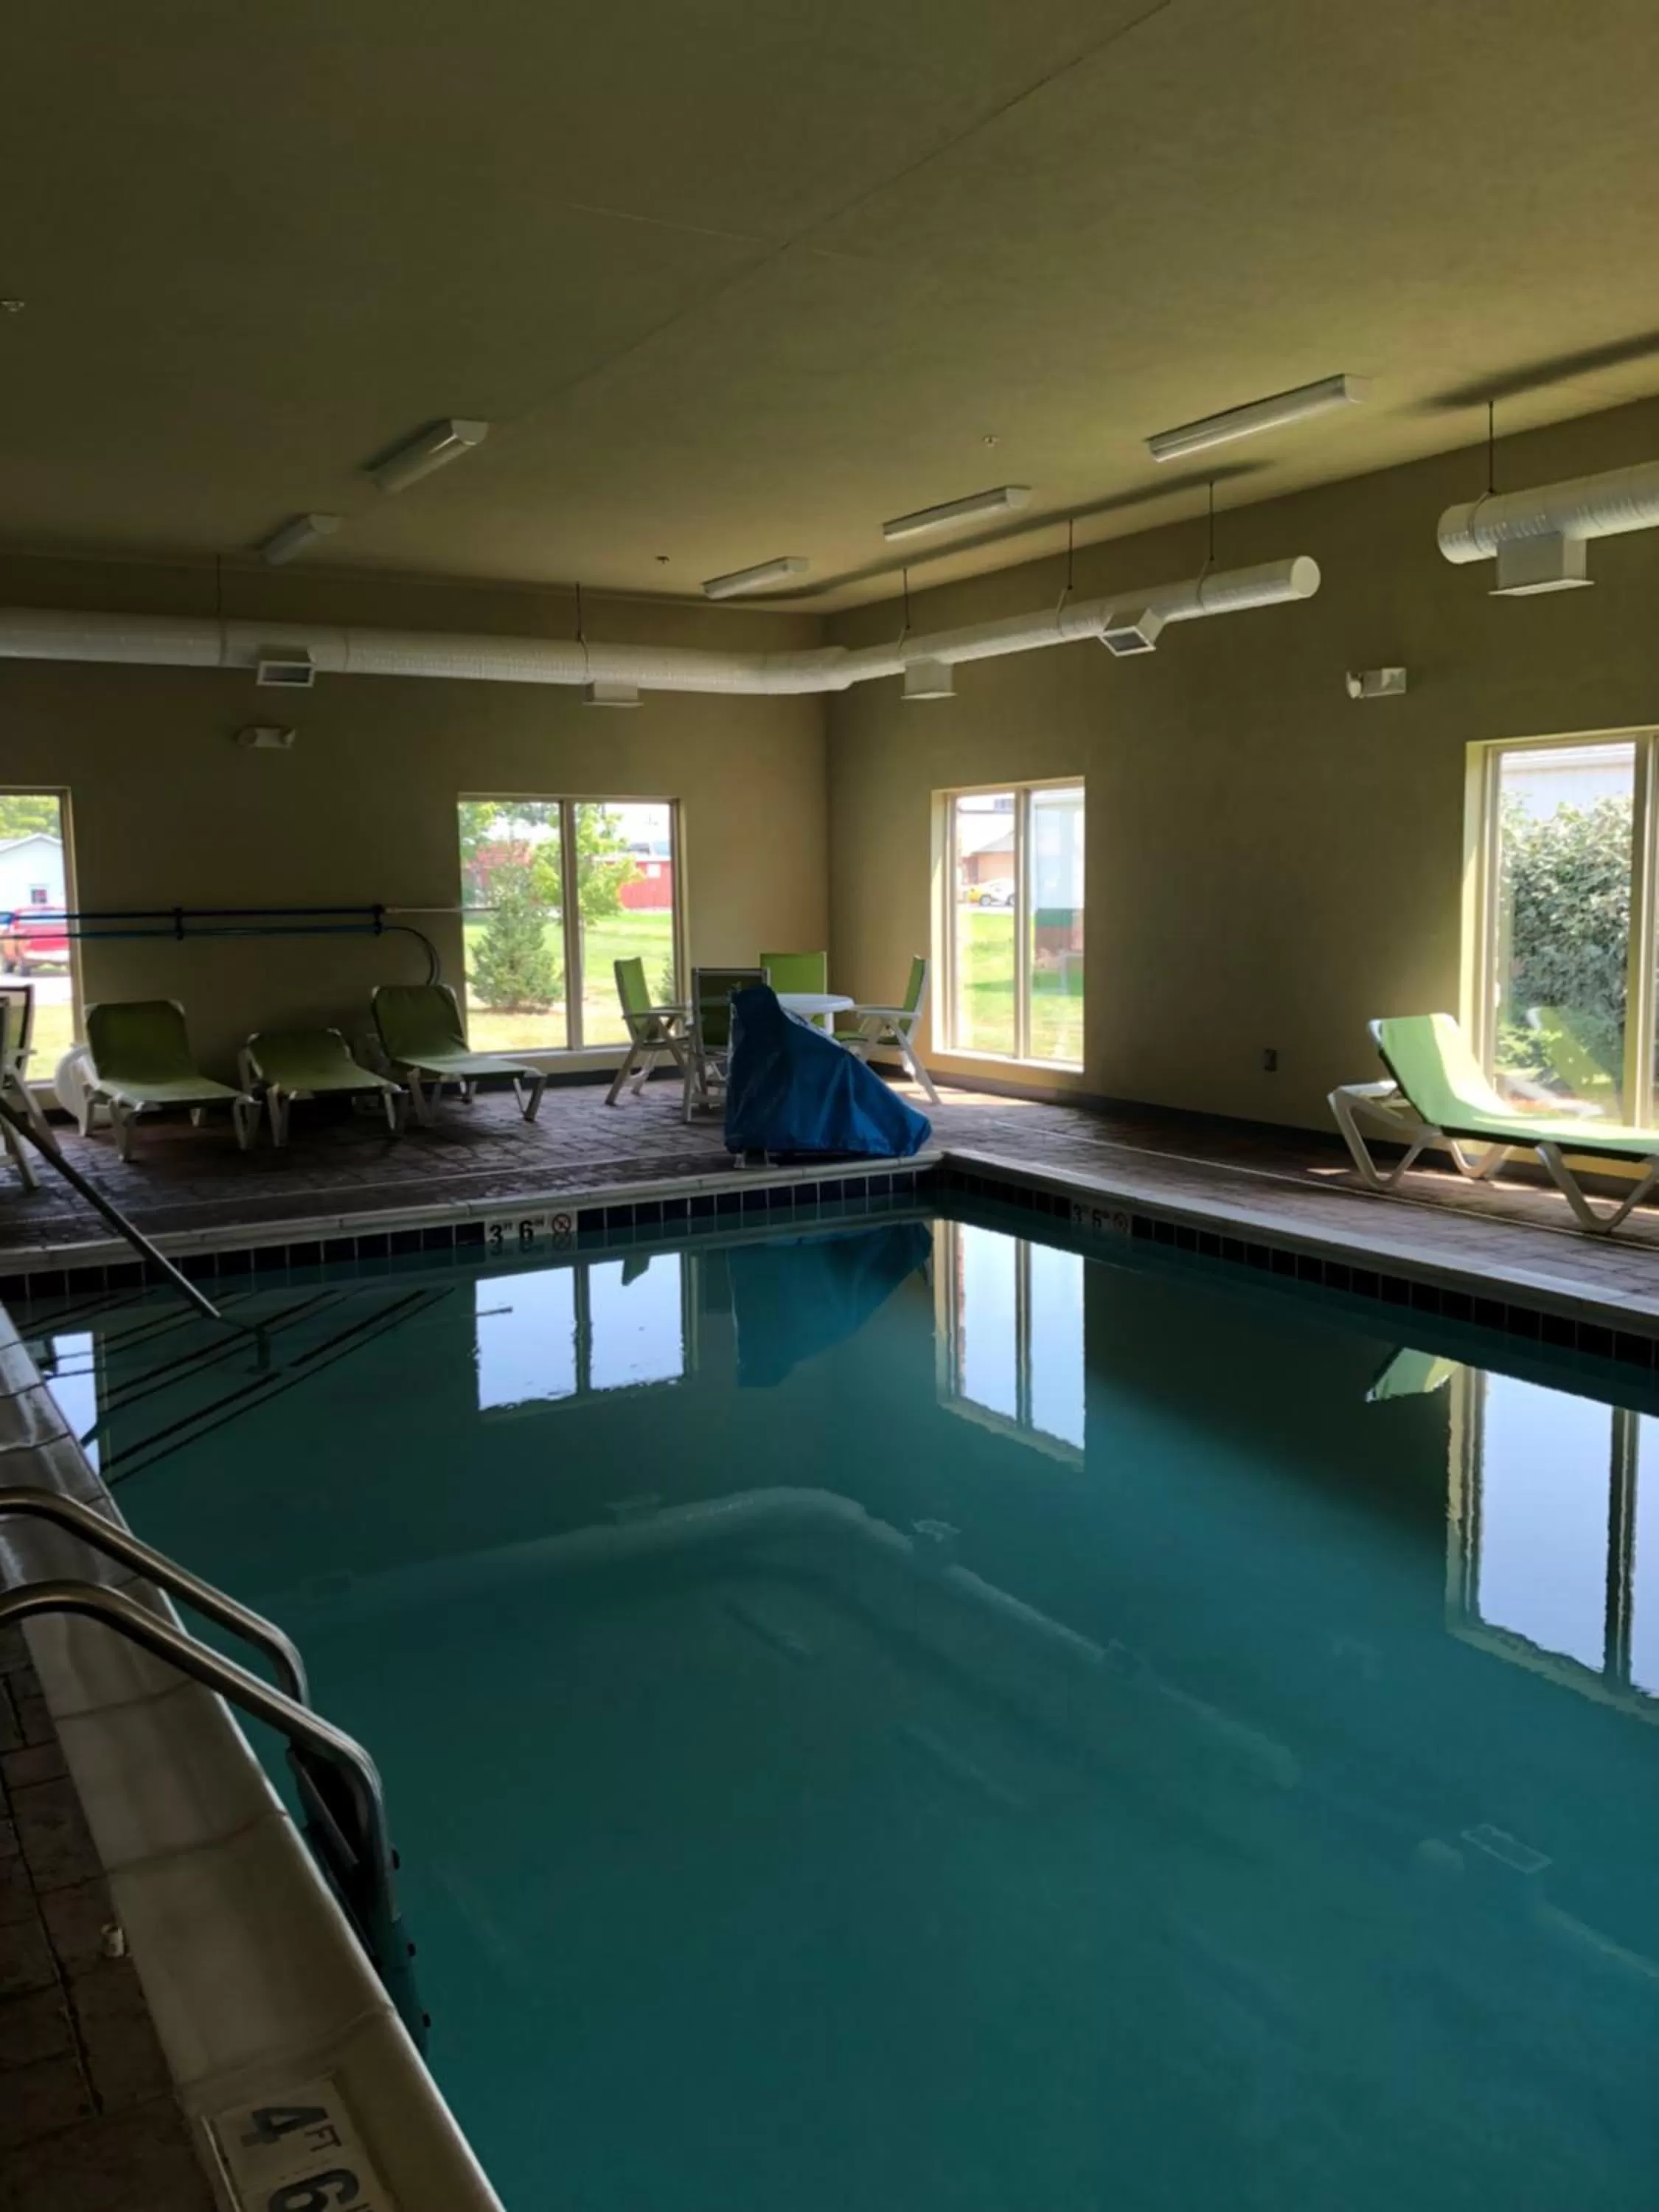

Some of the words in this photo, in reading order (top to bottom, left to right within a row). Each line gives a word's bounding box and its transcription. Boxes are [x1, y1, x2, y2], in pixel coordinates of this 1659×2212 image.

[489, 1224, 503, 1244] 3
[519, 1220, 534, 1242] 6
[240, 2106, 330, 2148] 4
[303, 2124, 343, 2152] FT
[268, 2168, 360, 2212] 6
